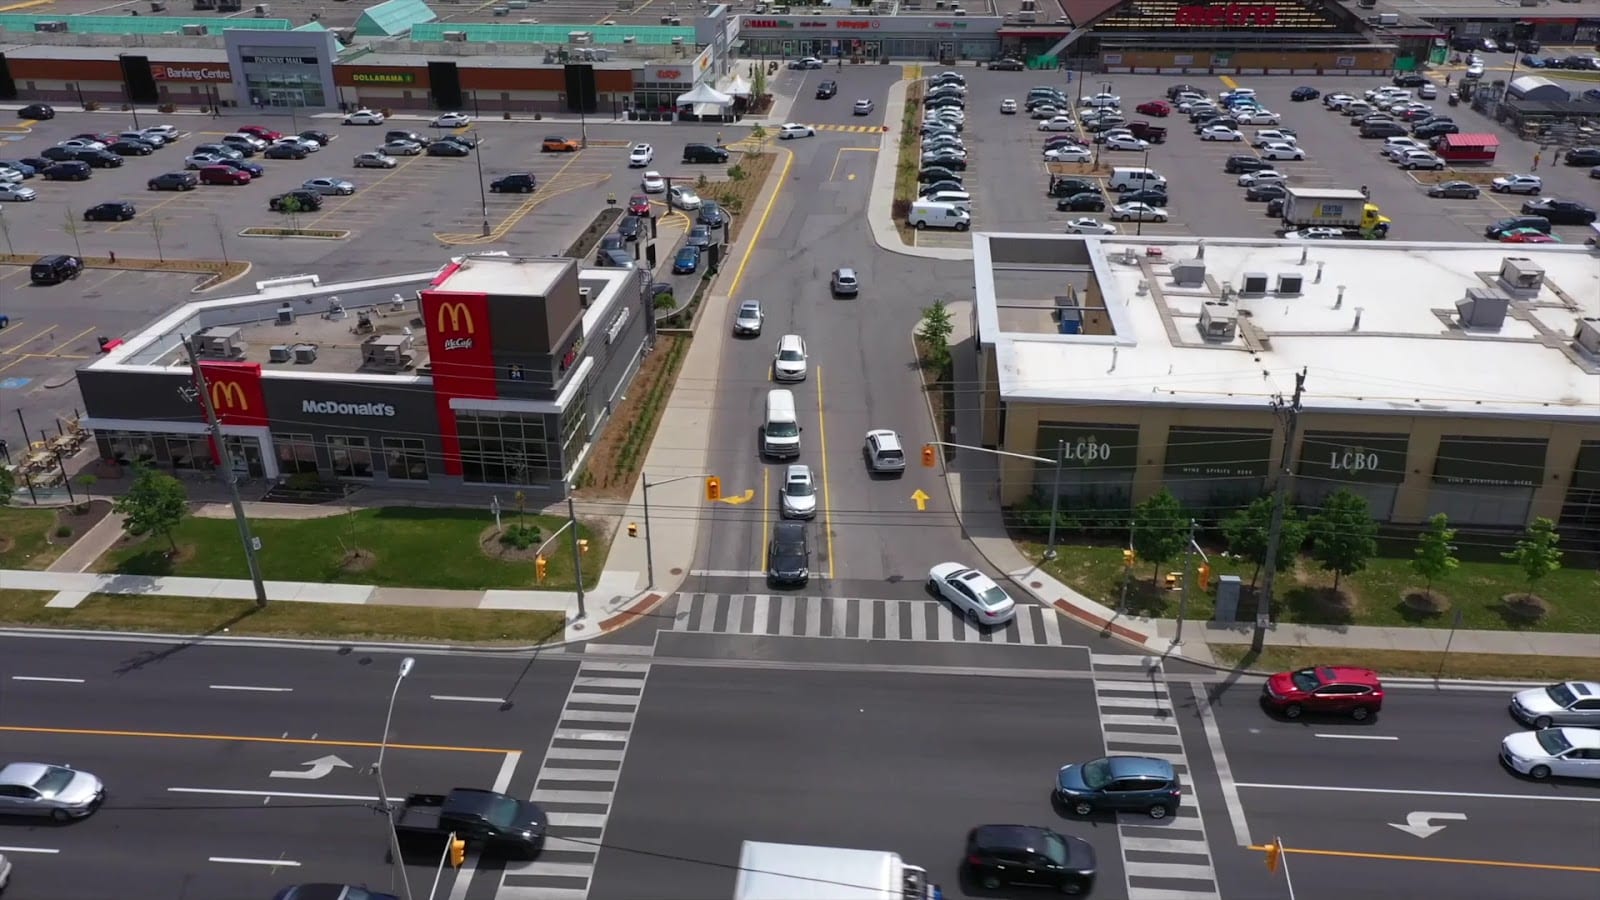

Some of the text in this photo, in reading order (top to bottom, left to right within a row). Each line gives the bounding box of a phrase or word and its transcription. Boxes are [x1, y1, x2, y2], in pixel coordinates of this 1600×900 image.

[286, 57, 304, 65] MALL
[167, 67, 230, 80] Banking Centre
[302, 400, 395, 416] McDonald's
[1064, 442, 1110, 460] LCBO
[1330, 451, 1378, 470] LCBO
